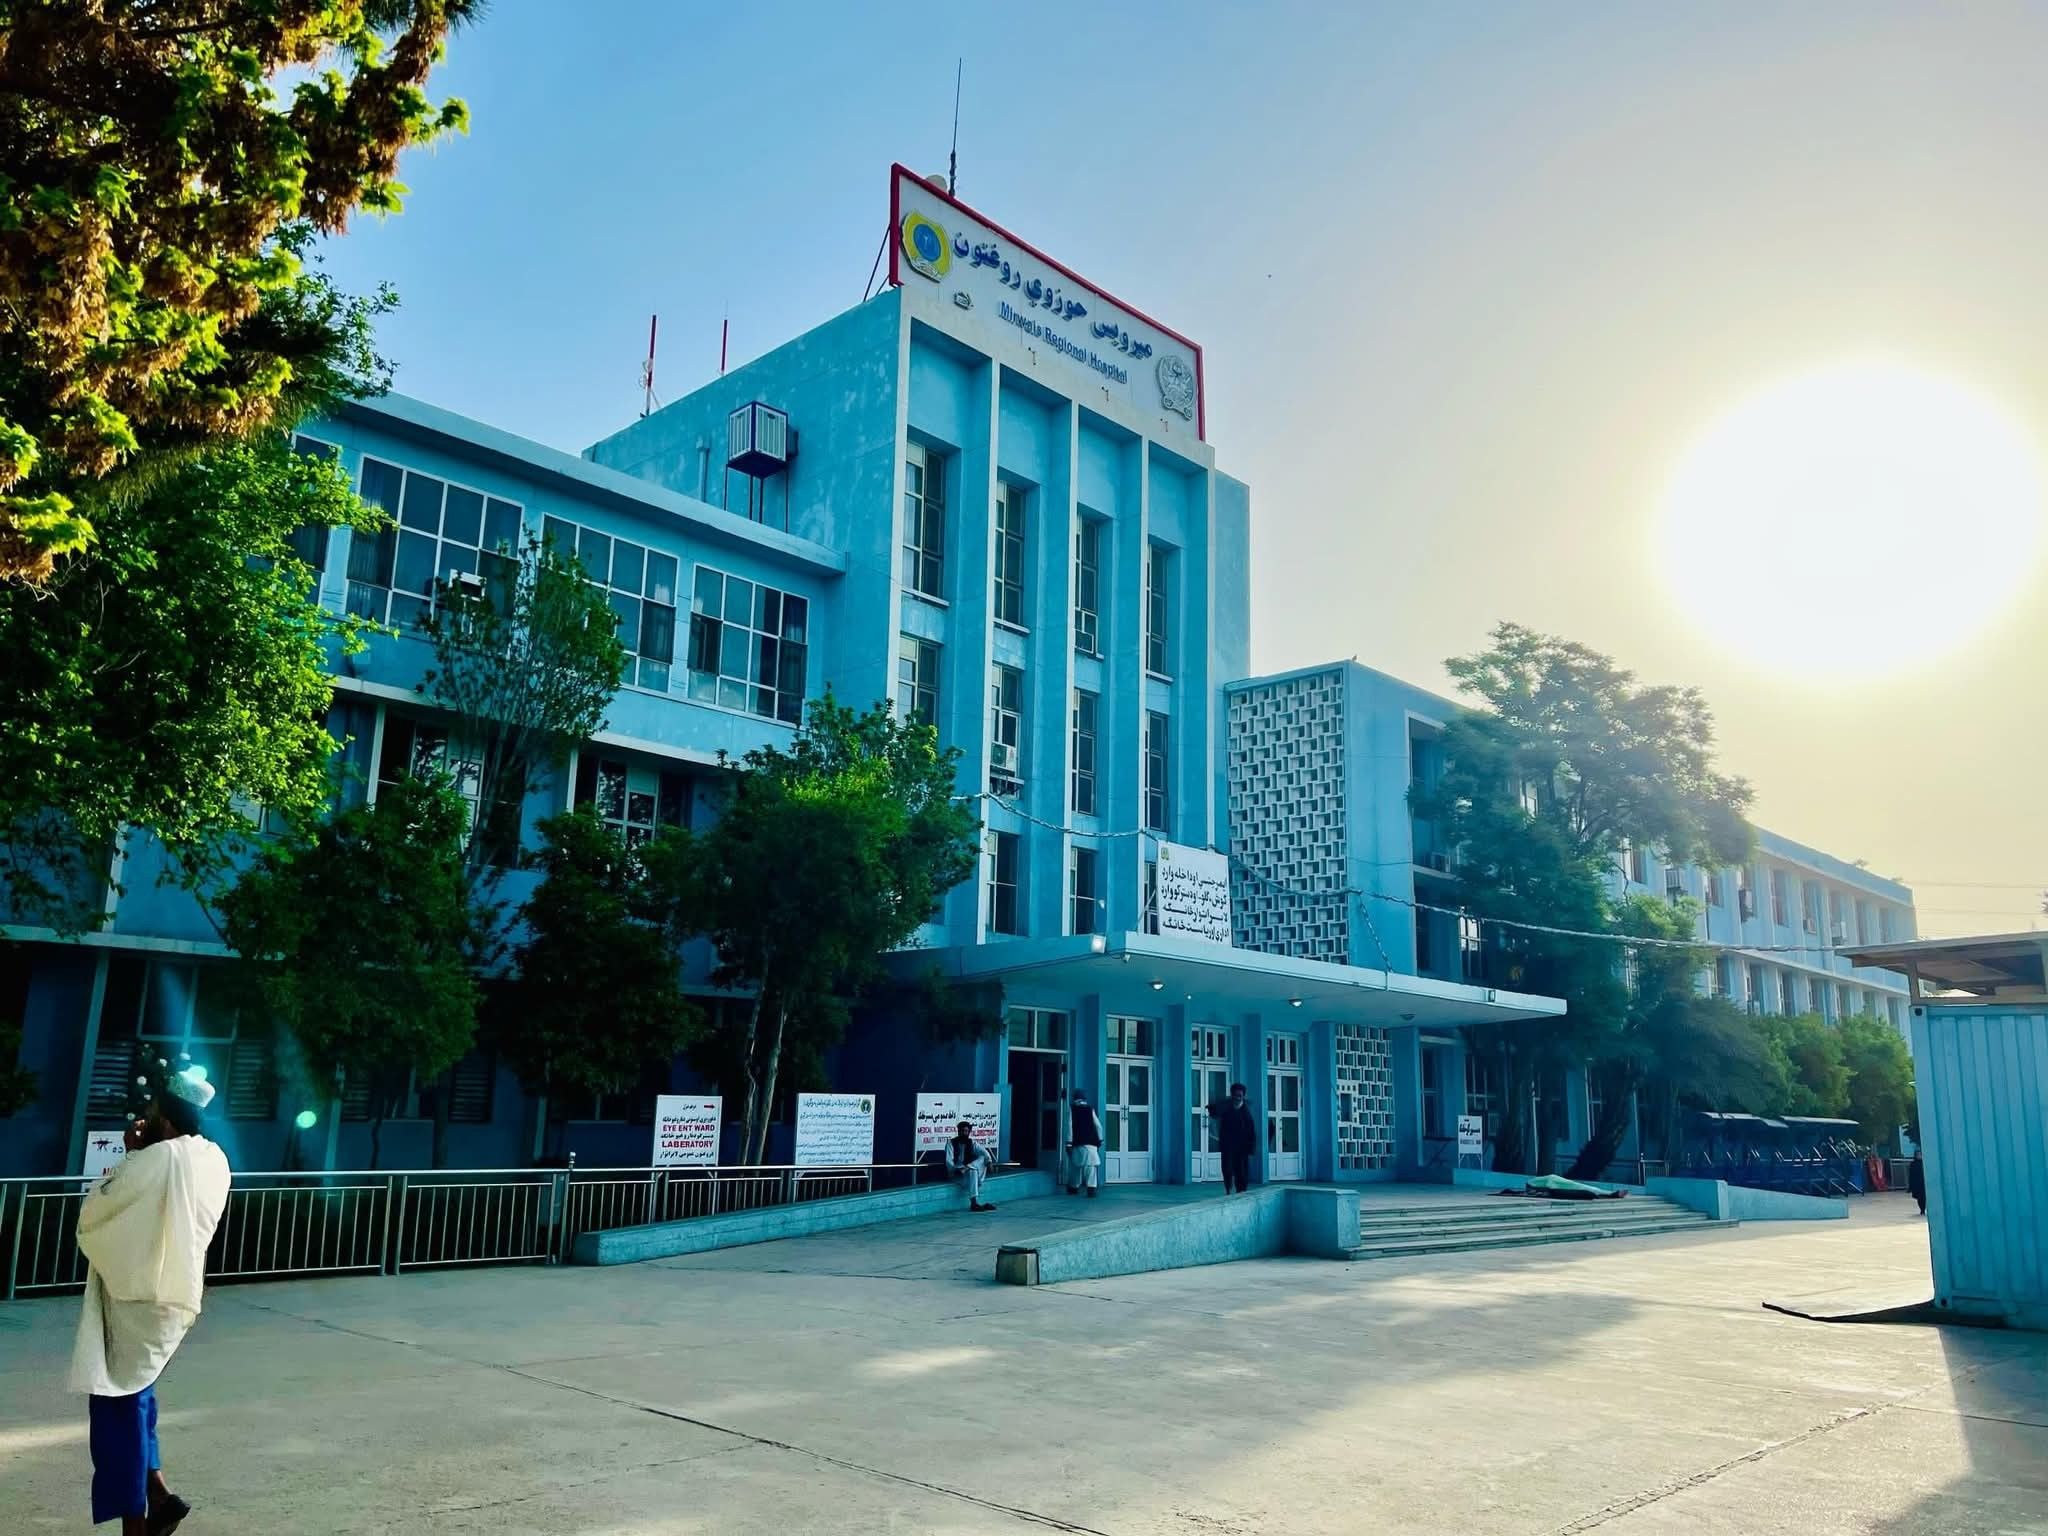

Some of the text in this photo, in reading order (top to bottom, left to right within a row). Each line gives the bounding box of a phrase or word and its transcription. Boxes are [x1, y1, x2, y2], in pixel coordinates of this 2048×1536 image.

[999, 302, 1127, 384] Mirwais Regional Hospital
[661, 1140, 713, 1148] LABERATORY
